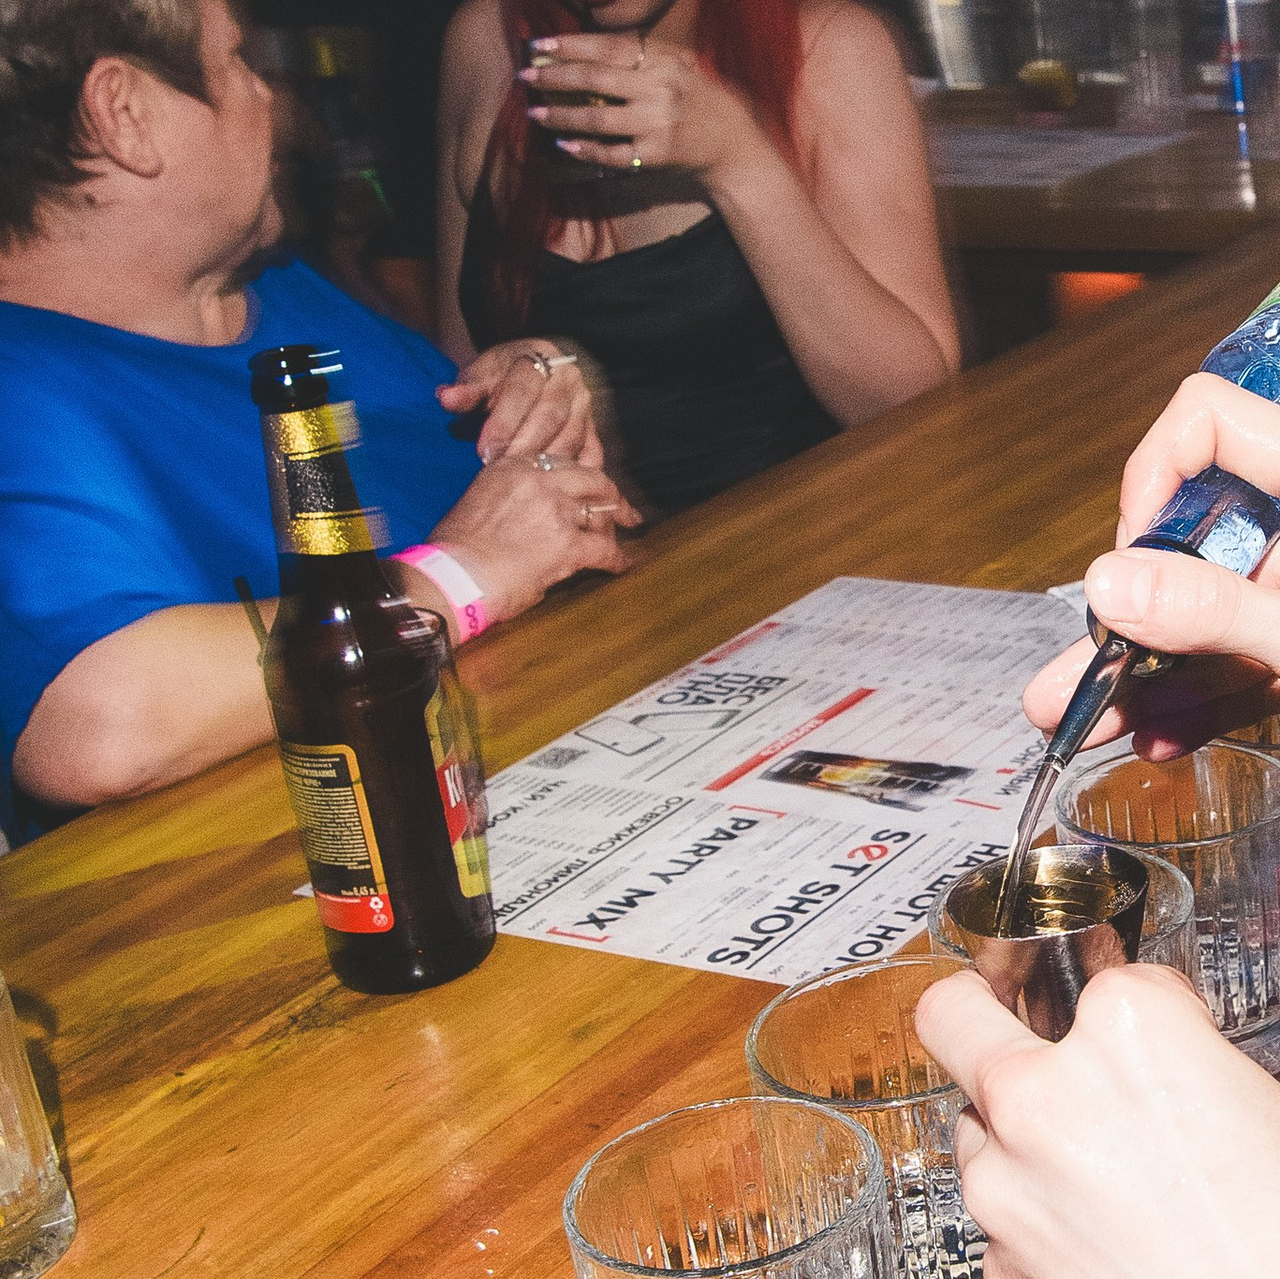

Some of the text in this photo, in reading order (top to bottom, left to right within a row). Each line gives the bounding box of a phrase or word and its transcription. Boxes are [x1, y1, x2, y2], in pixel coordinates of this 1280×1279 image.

[657, 672, 725, 705] ТНО
[721, 675, 788, 706] БЕС
[587, 795, 685, 855] ОСВЕЖИСЬ
[650, 817, 758, 884] PARTY
[953, 842, 1010, 871] НА
[574, 888, 656, 930] MIX
[707, 880, 840, 964] SHOTS
